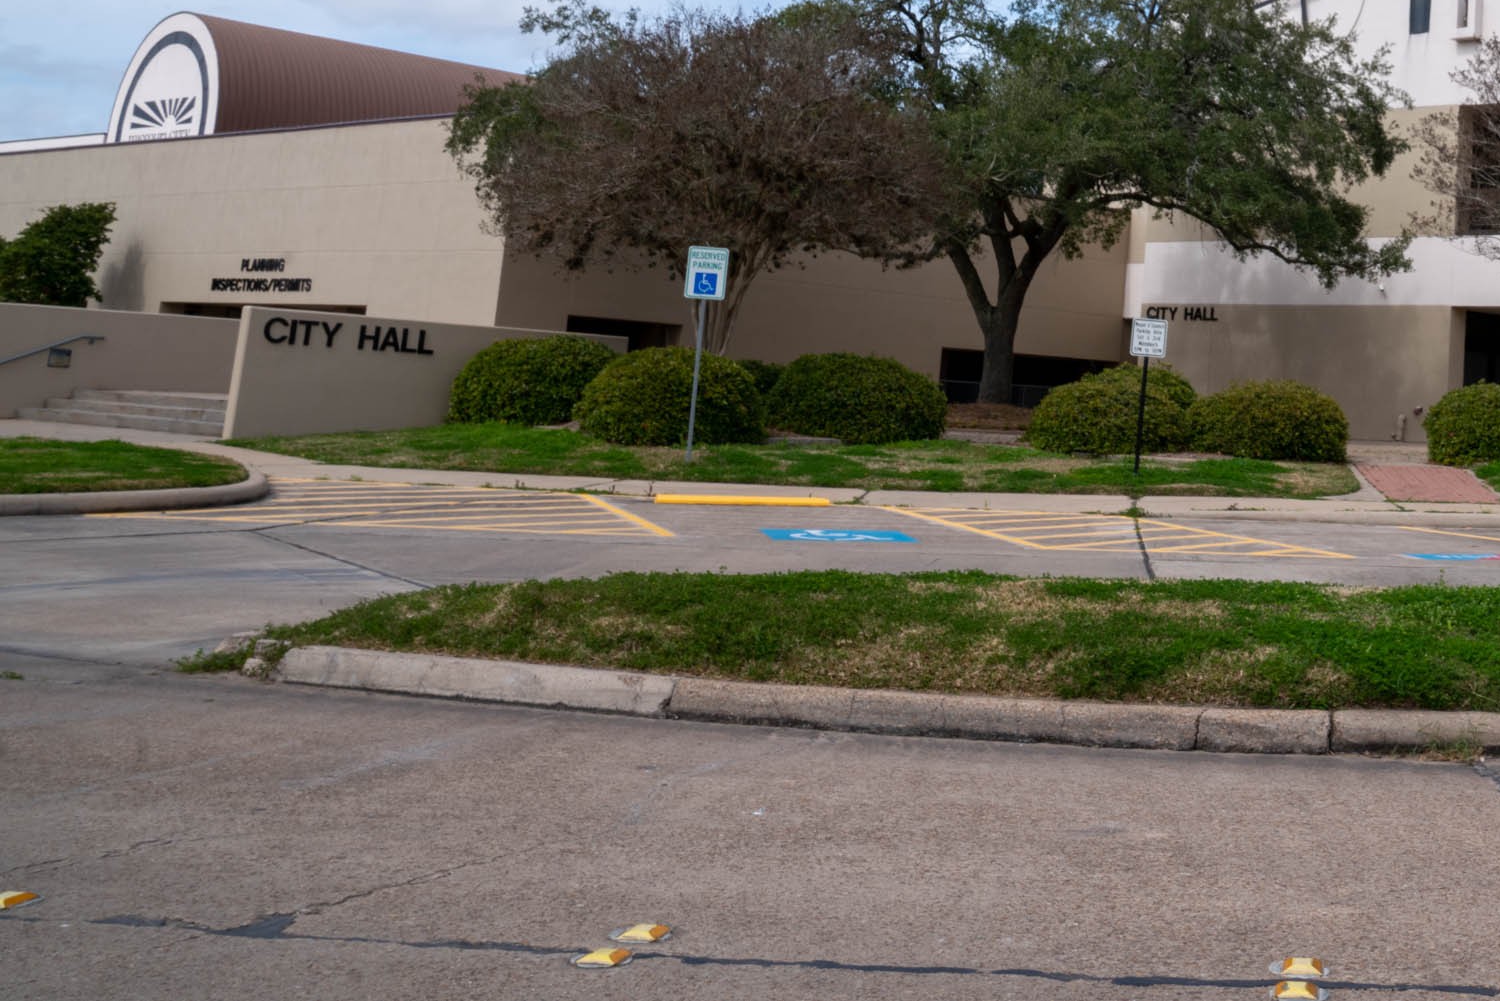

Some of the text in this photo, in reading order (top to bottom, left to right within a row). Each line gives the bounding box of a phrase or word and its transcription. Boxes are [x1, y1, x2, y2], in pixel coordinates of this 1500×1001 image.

[692, 251, 725, 261] RESERVED
[241, 258, 285, 272] PLANNING
[692, 261, 722, 270] PARKING
[211, 278, 312, 292] INSPECTIONS/PERMITS
[1146, 306, 1218, 321] CITY HALL
[264, 317, 434, 355] CITY HALL
